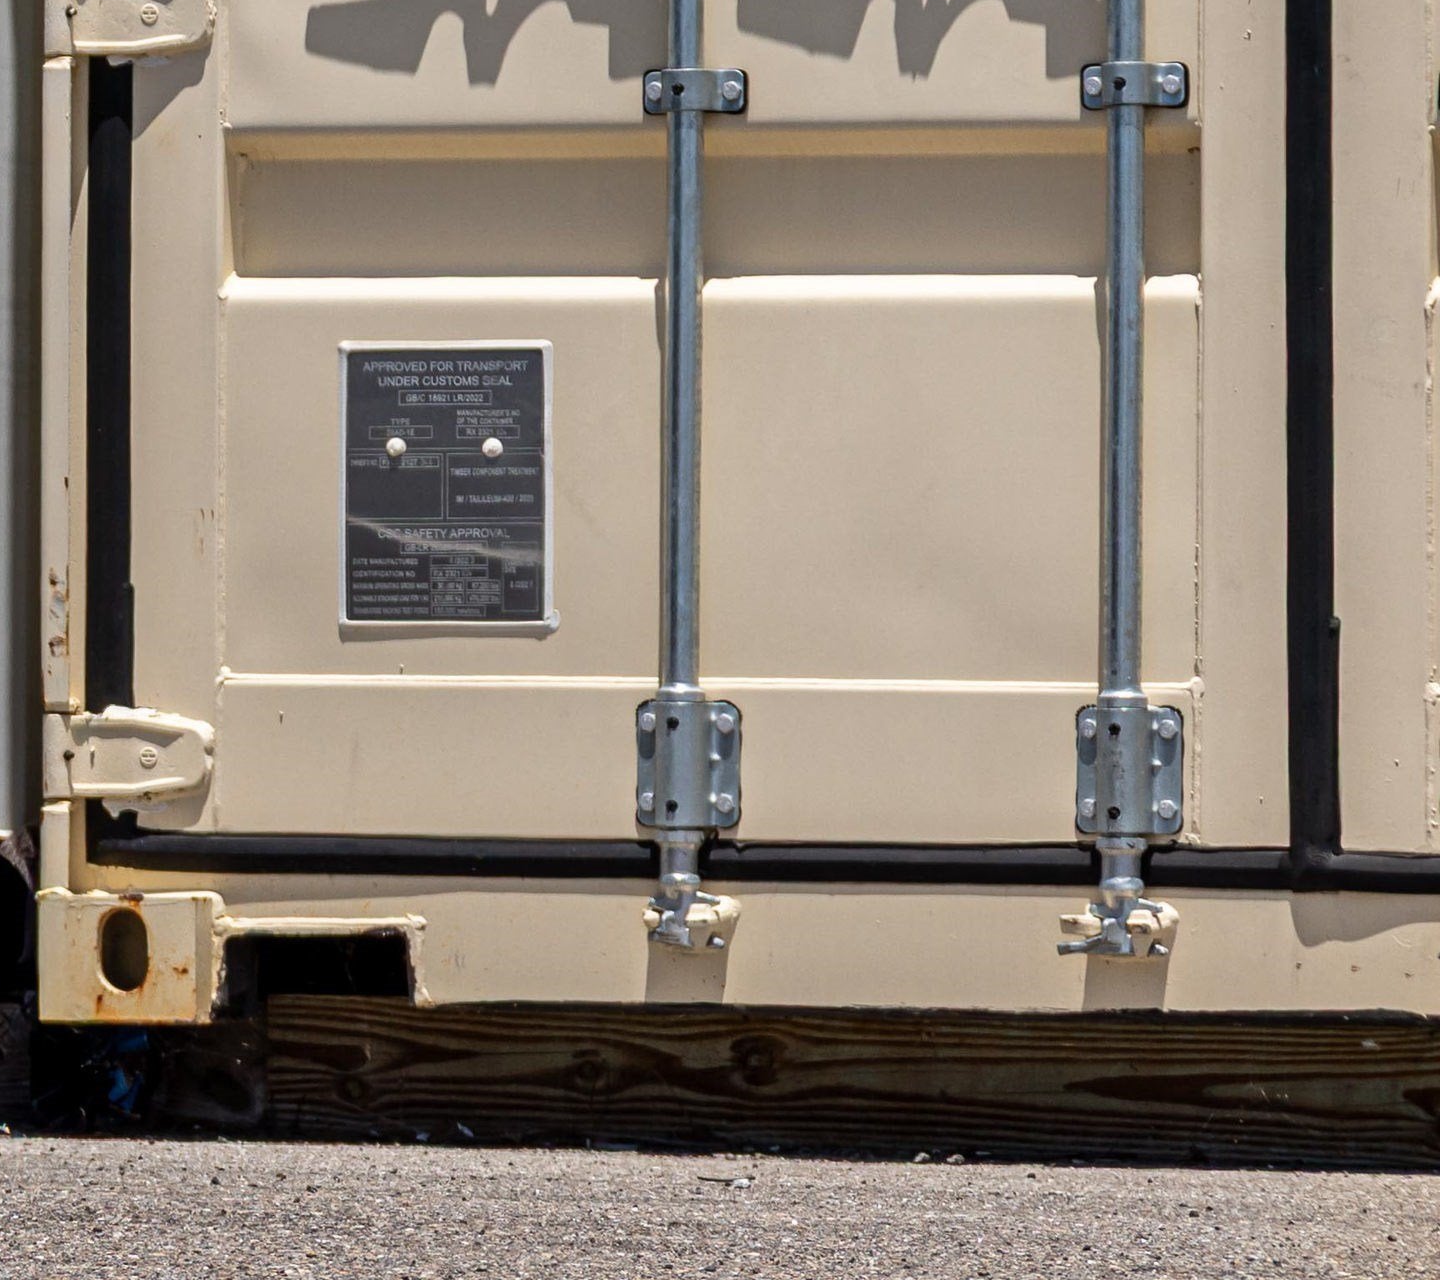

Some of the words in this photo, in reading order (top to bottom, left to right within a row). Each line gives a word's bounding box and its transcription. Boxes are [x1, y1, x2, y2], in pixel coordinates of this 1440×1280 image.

[363, 360, 428, 373] APPROVED
[430, 360, 453, 372] FOR
[457, 359, 528, 372] TRANSPORT
[378, 375, 420, 387] UNDER
[422, 375, 479, 387] CUSTOMS
[482, 375, 512, 387] SEAL
[404, 527, 448, 539] SAFETY
[449, 527, 510, 539] APPROVAL
